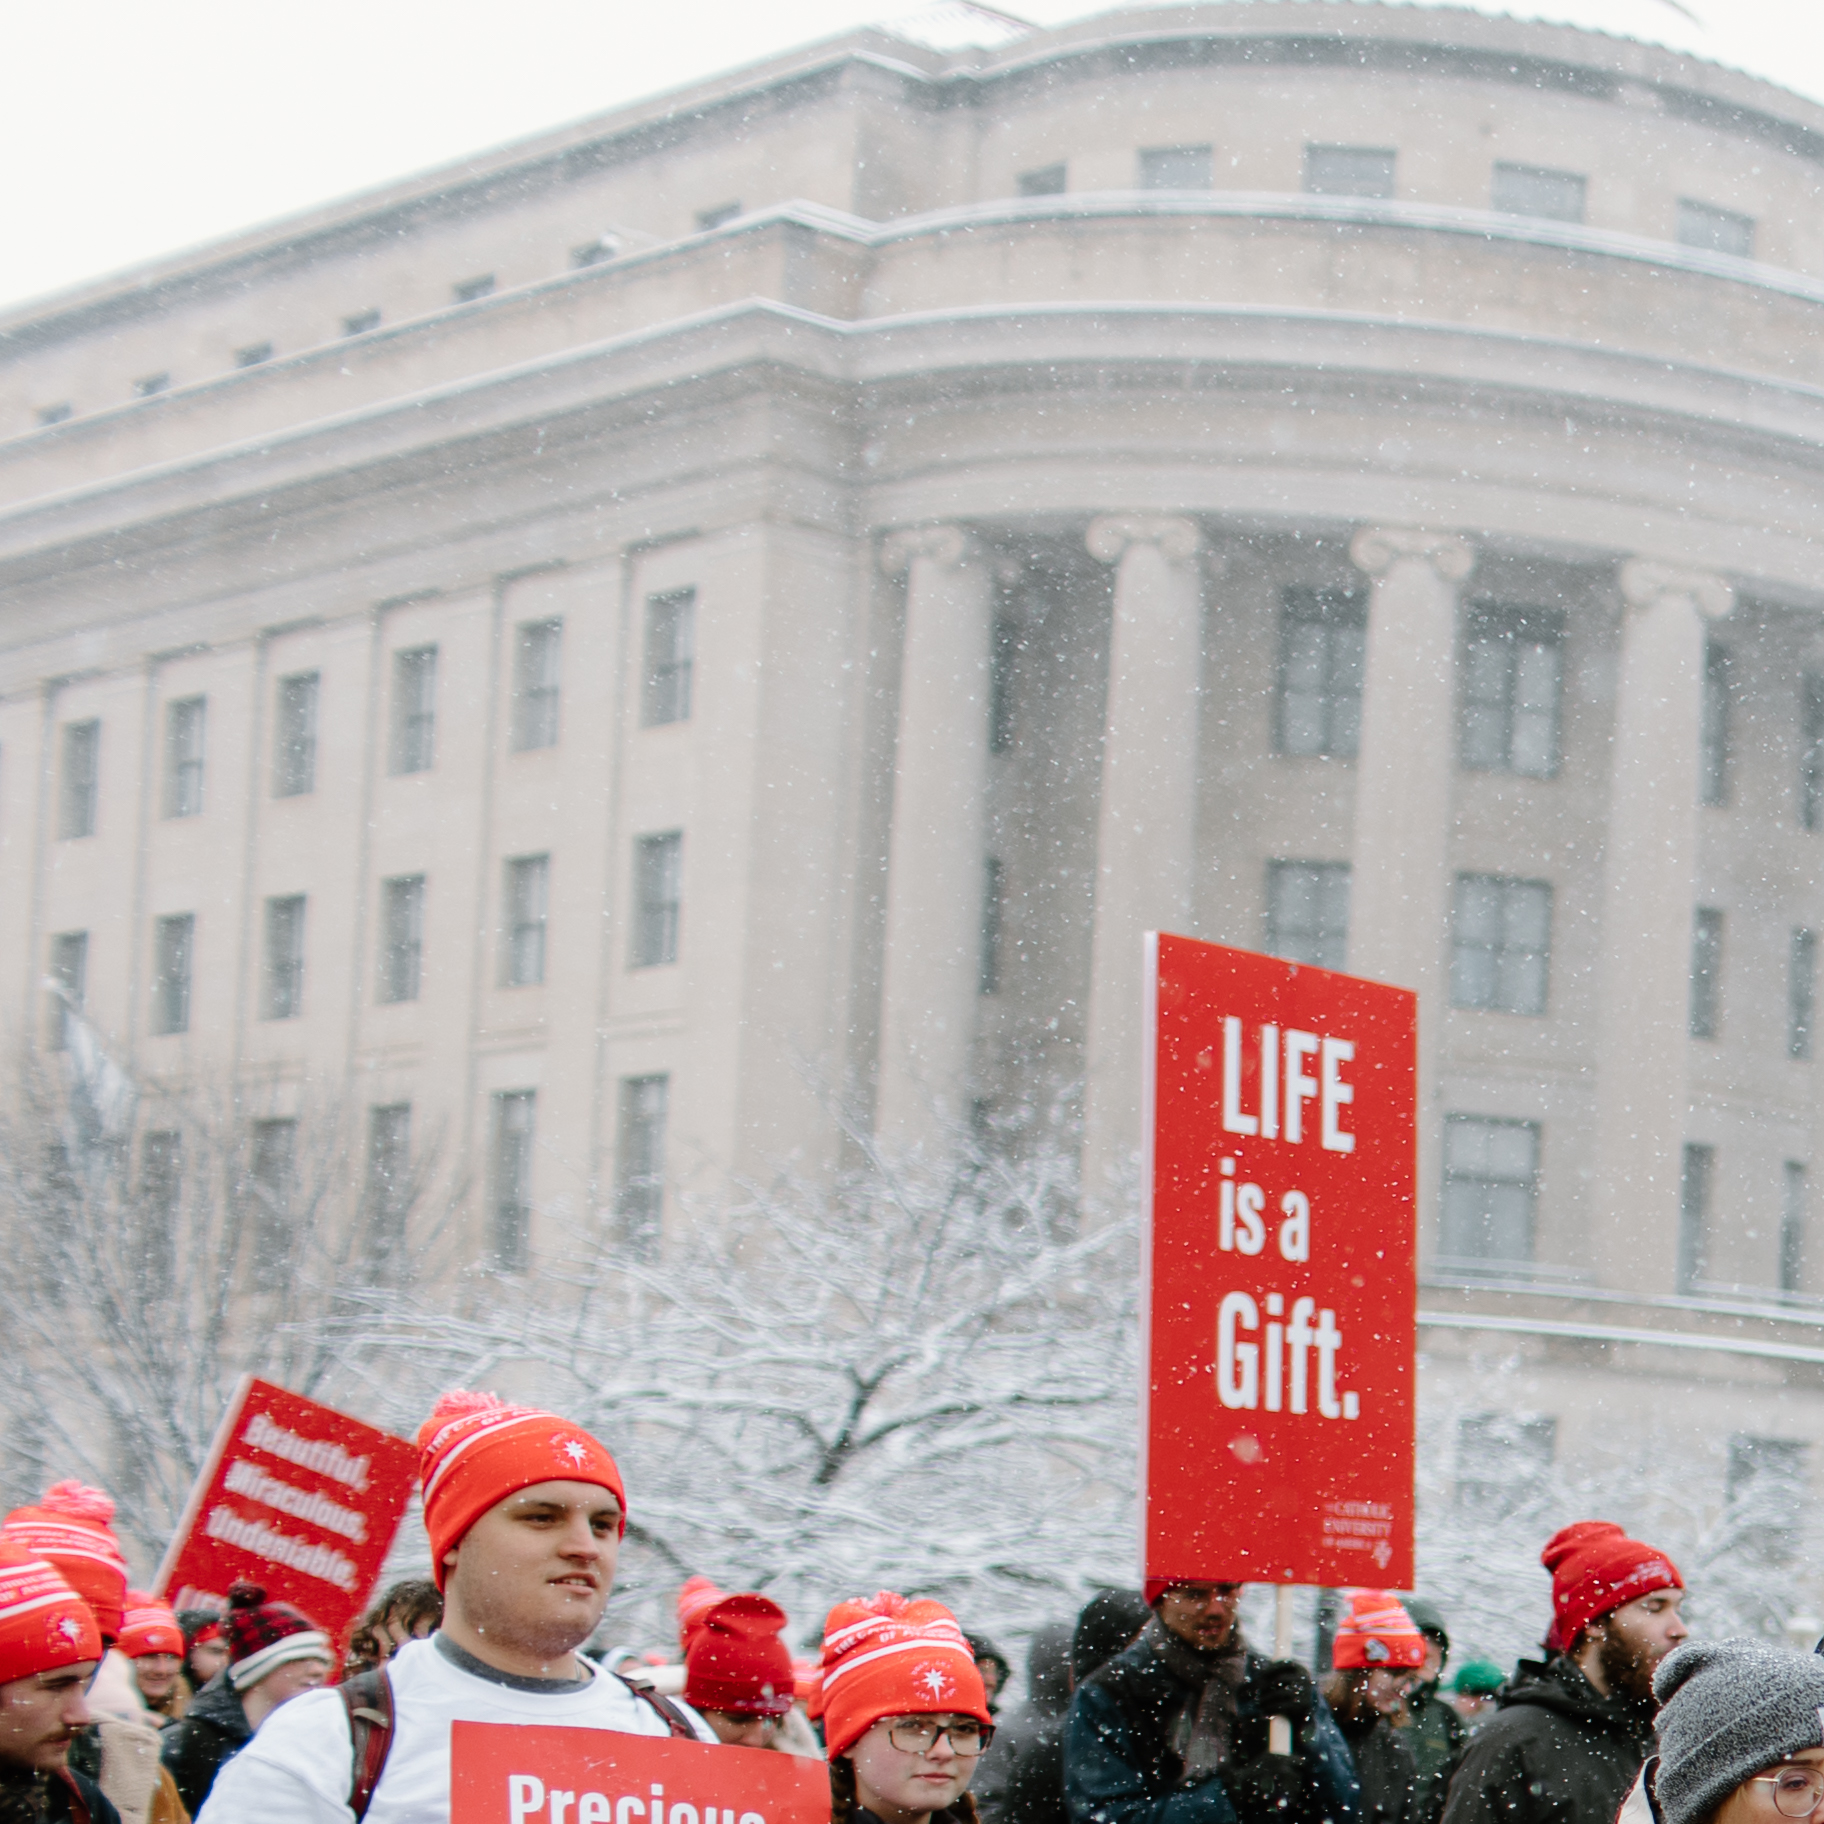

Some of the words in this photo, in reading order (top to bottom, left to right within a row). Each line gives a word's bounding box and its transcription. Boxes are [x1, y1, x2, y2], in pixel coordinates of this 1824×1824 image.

[1223, 1016, 1355, 1153] LIFE
[1218, 1157, 1265, 1255] is
[1279, 1189, 1309, 1262] a
[1217, 1291, 1359, 1420] Gift.
